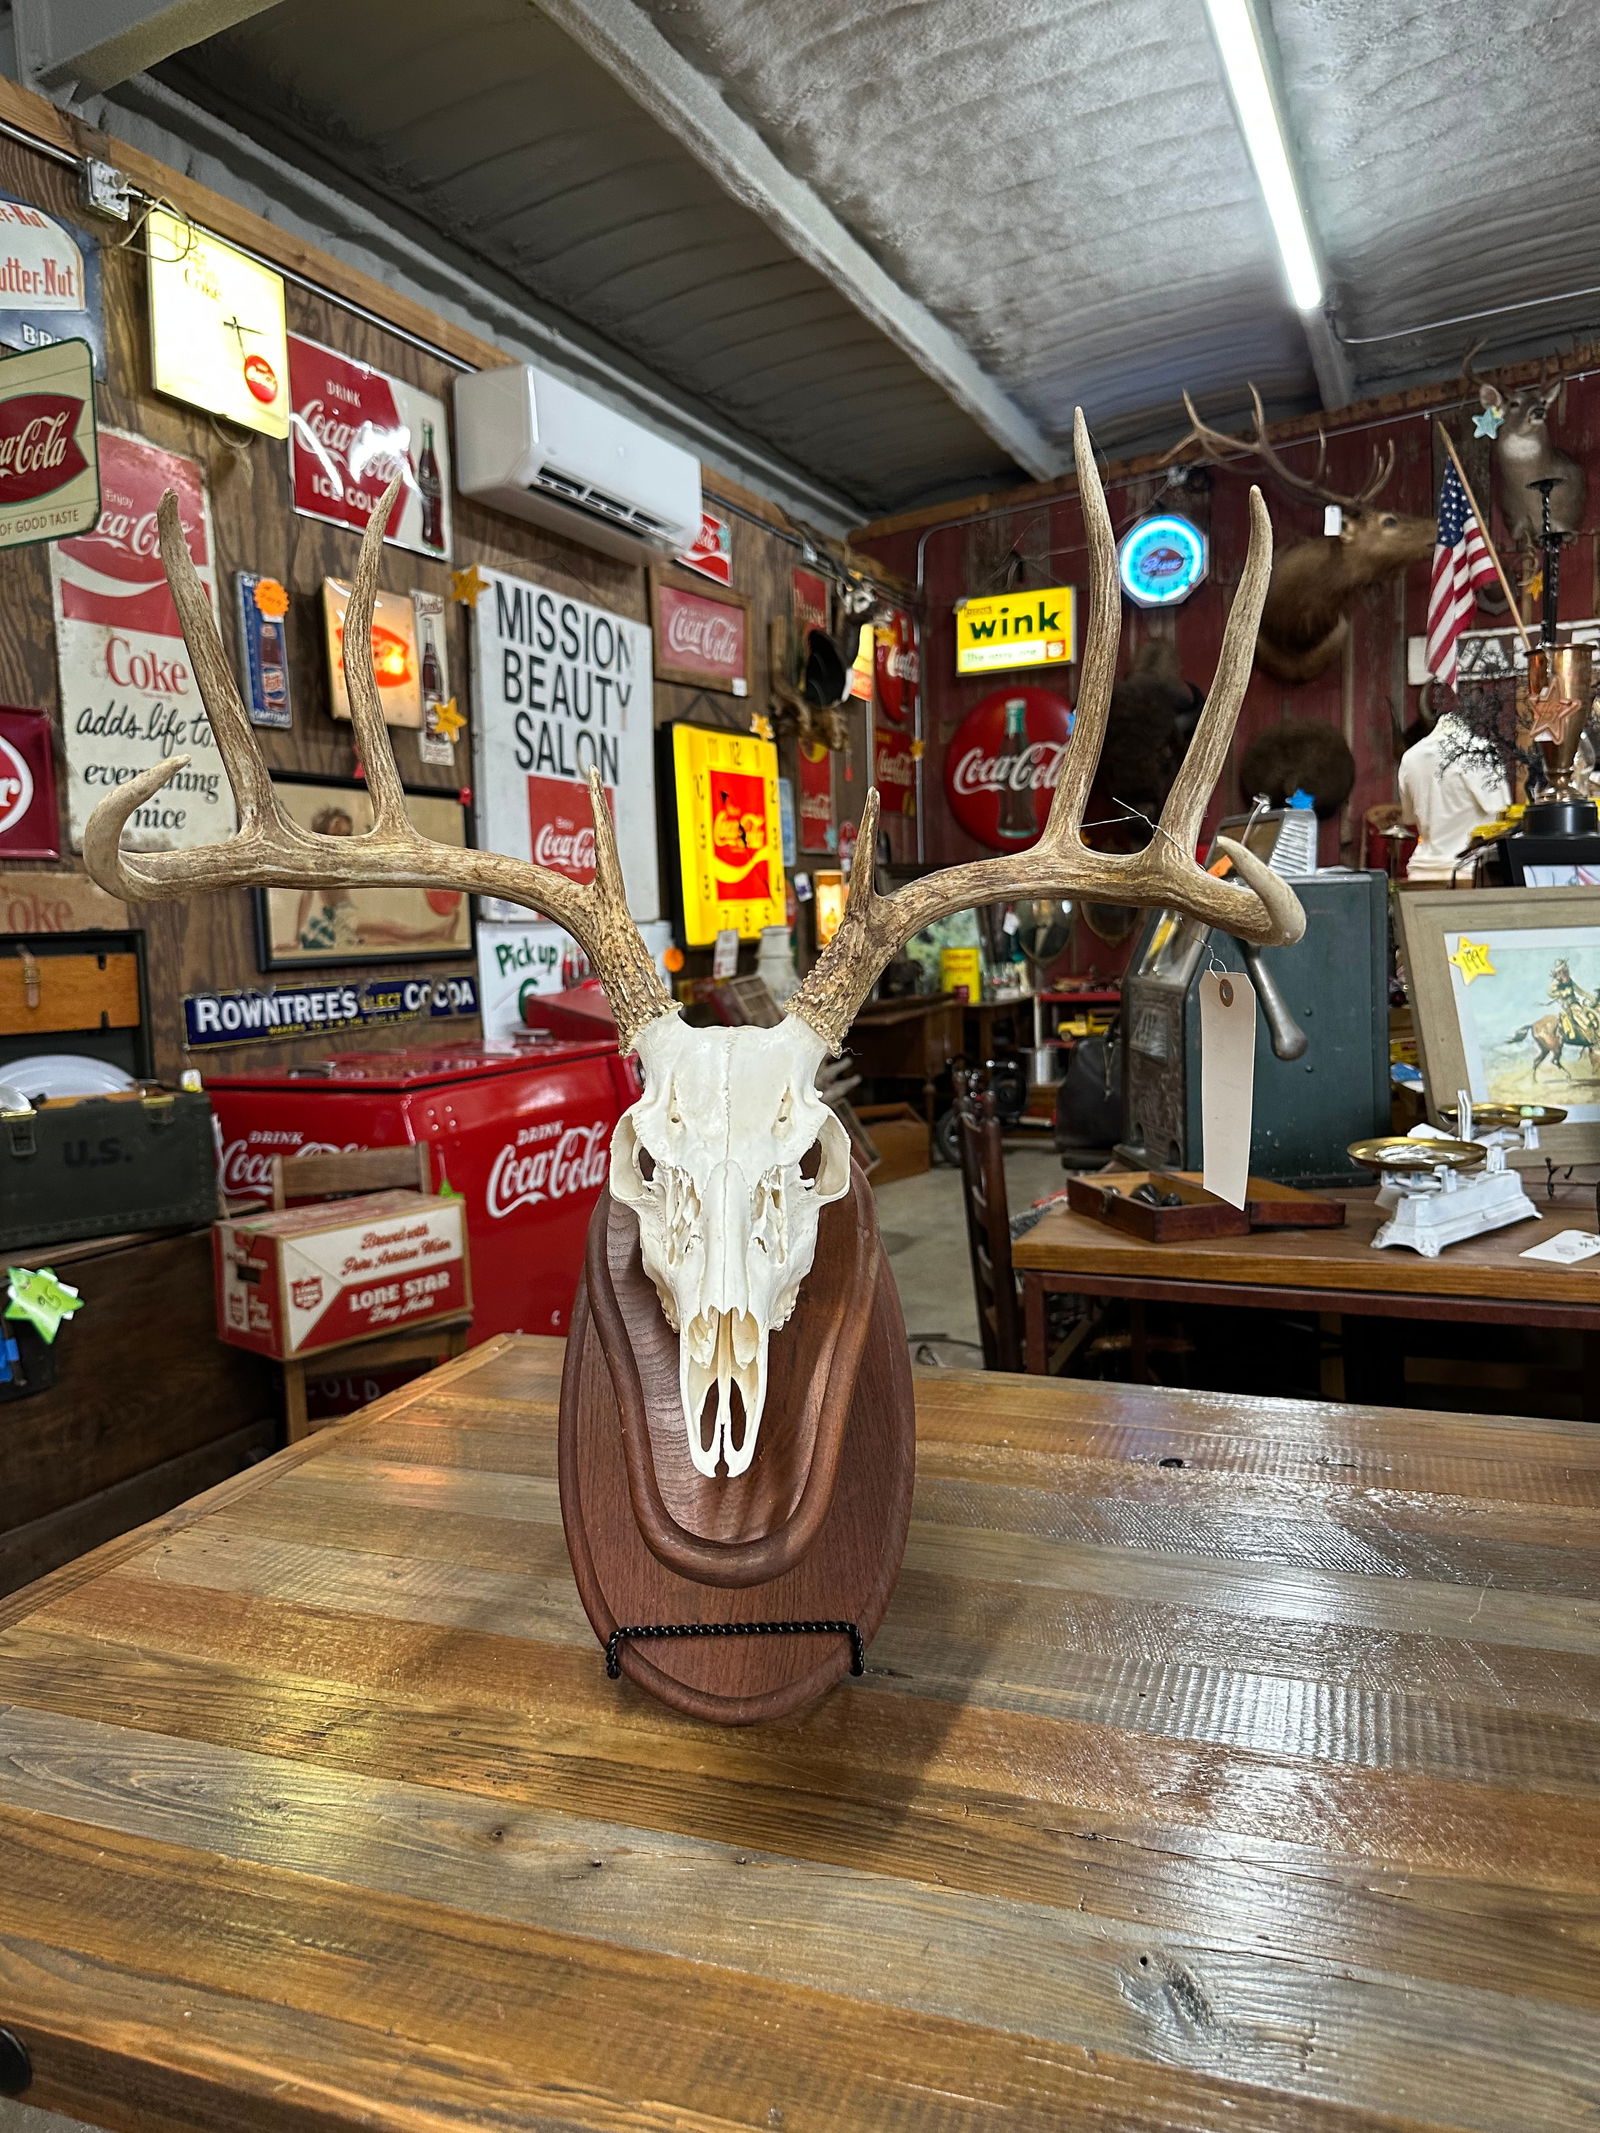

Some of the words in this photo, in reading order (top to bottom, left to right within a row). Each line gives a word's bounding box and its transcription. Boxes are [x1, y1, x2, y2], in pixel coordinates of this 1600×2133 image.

[326, 379, 361, 408] DRINK
[294, 399, 405, 485] Coca-ola
[0, 523, 12, 536] OF
[15, 515, 48, 534] GOOD
[50, 509, 80, 528] TASTE
[495, 579, 634, 674] MISSION
[668, 607, 737, 664] Coca-Cola
[970, 601, 1062, 640] wink
[105, 635, 189, 696] Coke
[503, 648, 632, 731] BEAUTY
[76, 700, 141, 740] adds
[142, 702, 187, 757] life
[515, 711, 620, 785] SALON
[84, 762, 221, 804] everhing
[953, 741, 1069, 795] Coca-Col
[134, 798, 187, 829] nice
[536, 823, 597, 868] Coca-Co
[495, 934, 536, 977] Pick
[538, 943, 559, 968] up
[196, 986, 358, 1033] ROWNTREE'S
[404, 979, 475, 1012] COCOA
[63, 1136, 134, 1169] U.S.
[249, 1131, 304, 1145] DRINK
[516, 1120, 564, 1146] DRINK
[486, 1121, 609, 1219] Coca-Cola
[350, 1283, 400, 1312] LONE
[403, 1271, 451, 1298] STAR
[308, 1378, 381, 1401] OLD
